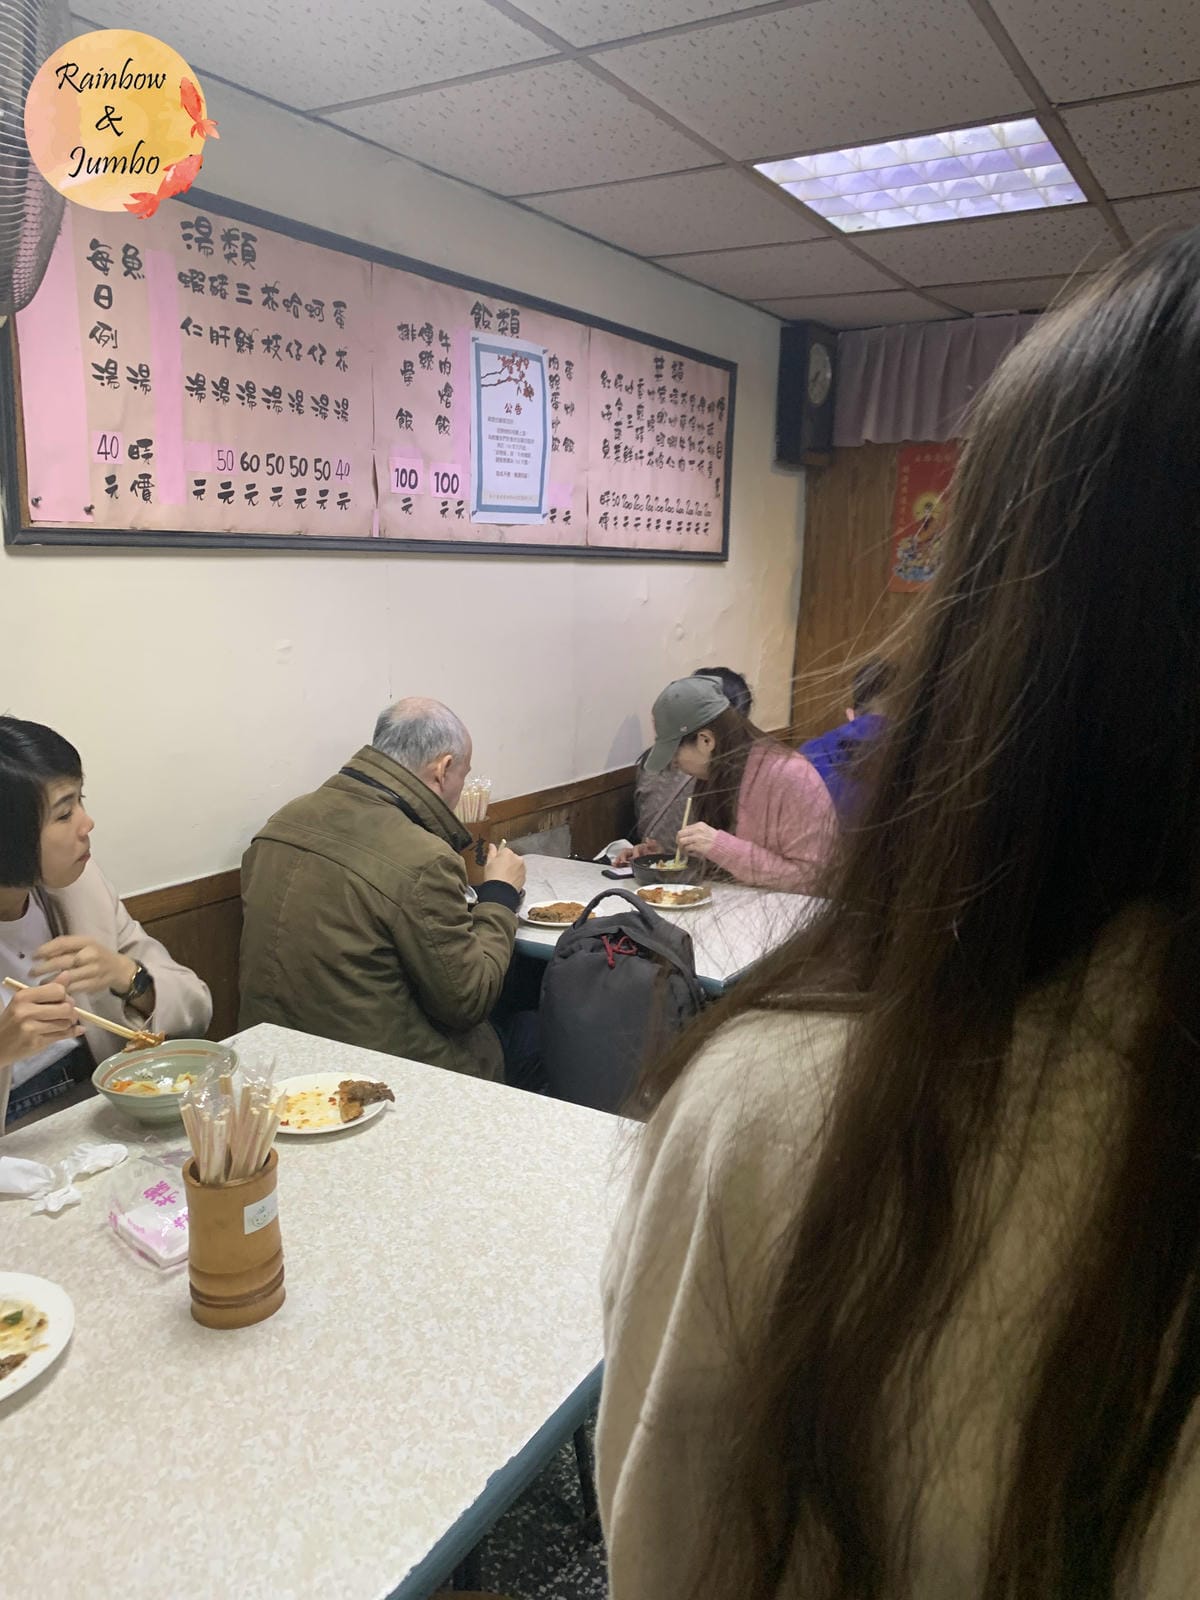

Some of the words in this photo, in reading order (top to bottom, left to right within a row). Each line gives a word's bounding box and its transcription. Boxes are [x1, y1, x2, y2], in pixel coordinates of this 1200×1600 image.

[180, 216, 258, 270] 湯類
[471, 301, 521, 338] 飯類
[504, 402, 523, 416] 公告
[97, 434, 120, 460] 40
[216, 449, 235, 472] 50
[240, 452, 260, 474] 60
[265, 452, 285, 475] 50
[289, 455, 308, 479] 50
[314, 457, 331, 481] 50
[335, 458, 351, 480] 40
[394, 468, 419, 490] 100
[434, 471, 460, 495] 100
